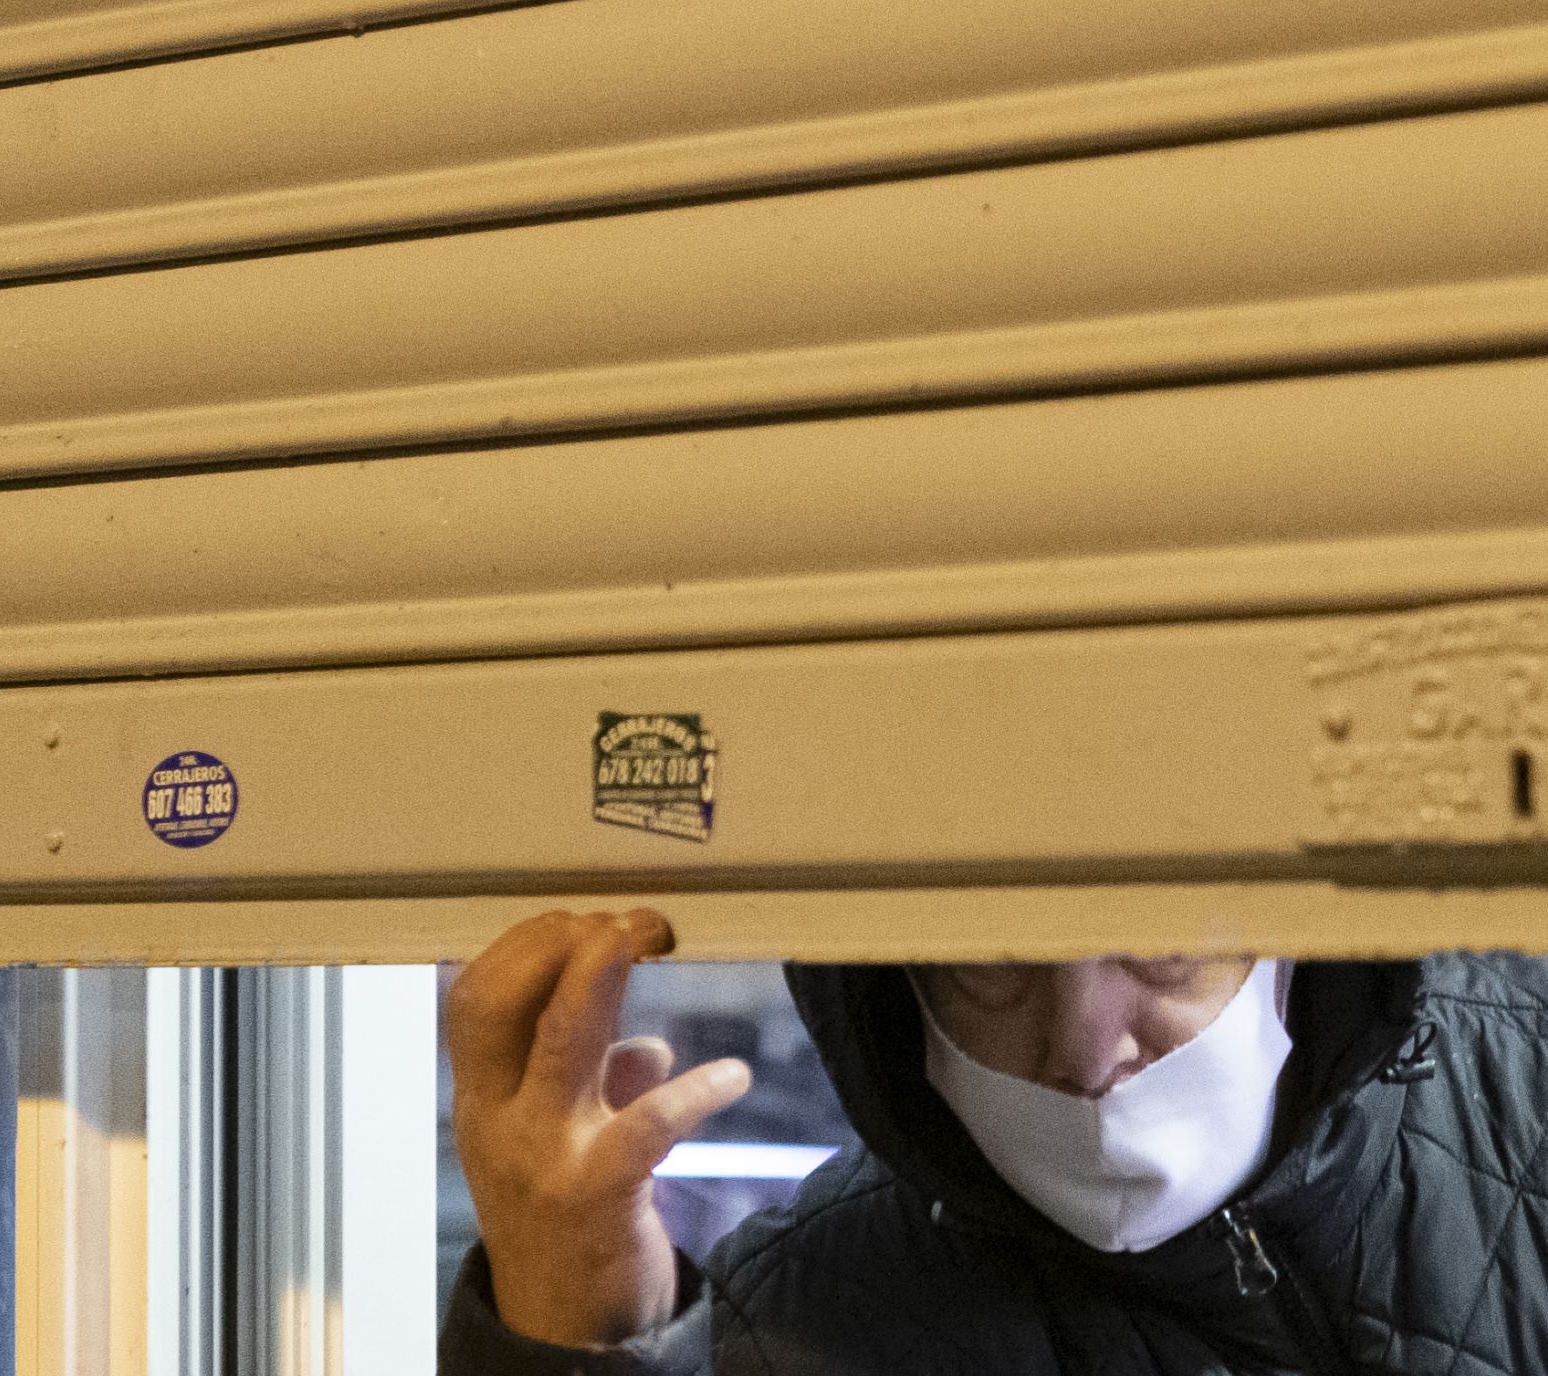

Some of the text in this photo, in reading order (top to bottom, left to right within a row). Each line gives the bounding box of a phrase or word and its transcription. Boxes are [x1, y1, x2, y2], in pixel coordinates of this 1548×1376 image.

[599, 716, 697, 753] CERRAJEROS
[153, 766, 226, 786] CERRAJEROS
[598, 756, 698, 785] 678 242 018
[148, 783, 232, 819] 607 466 383
